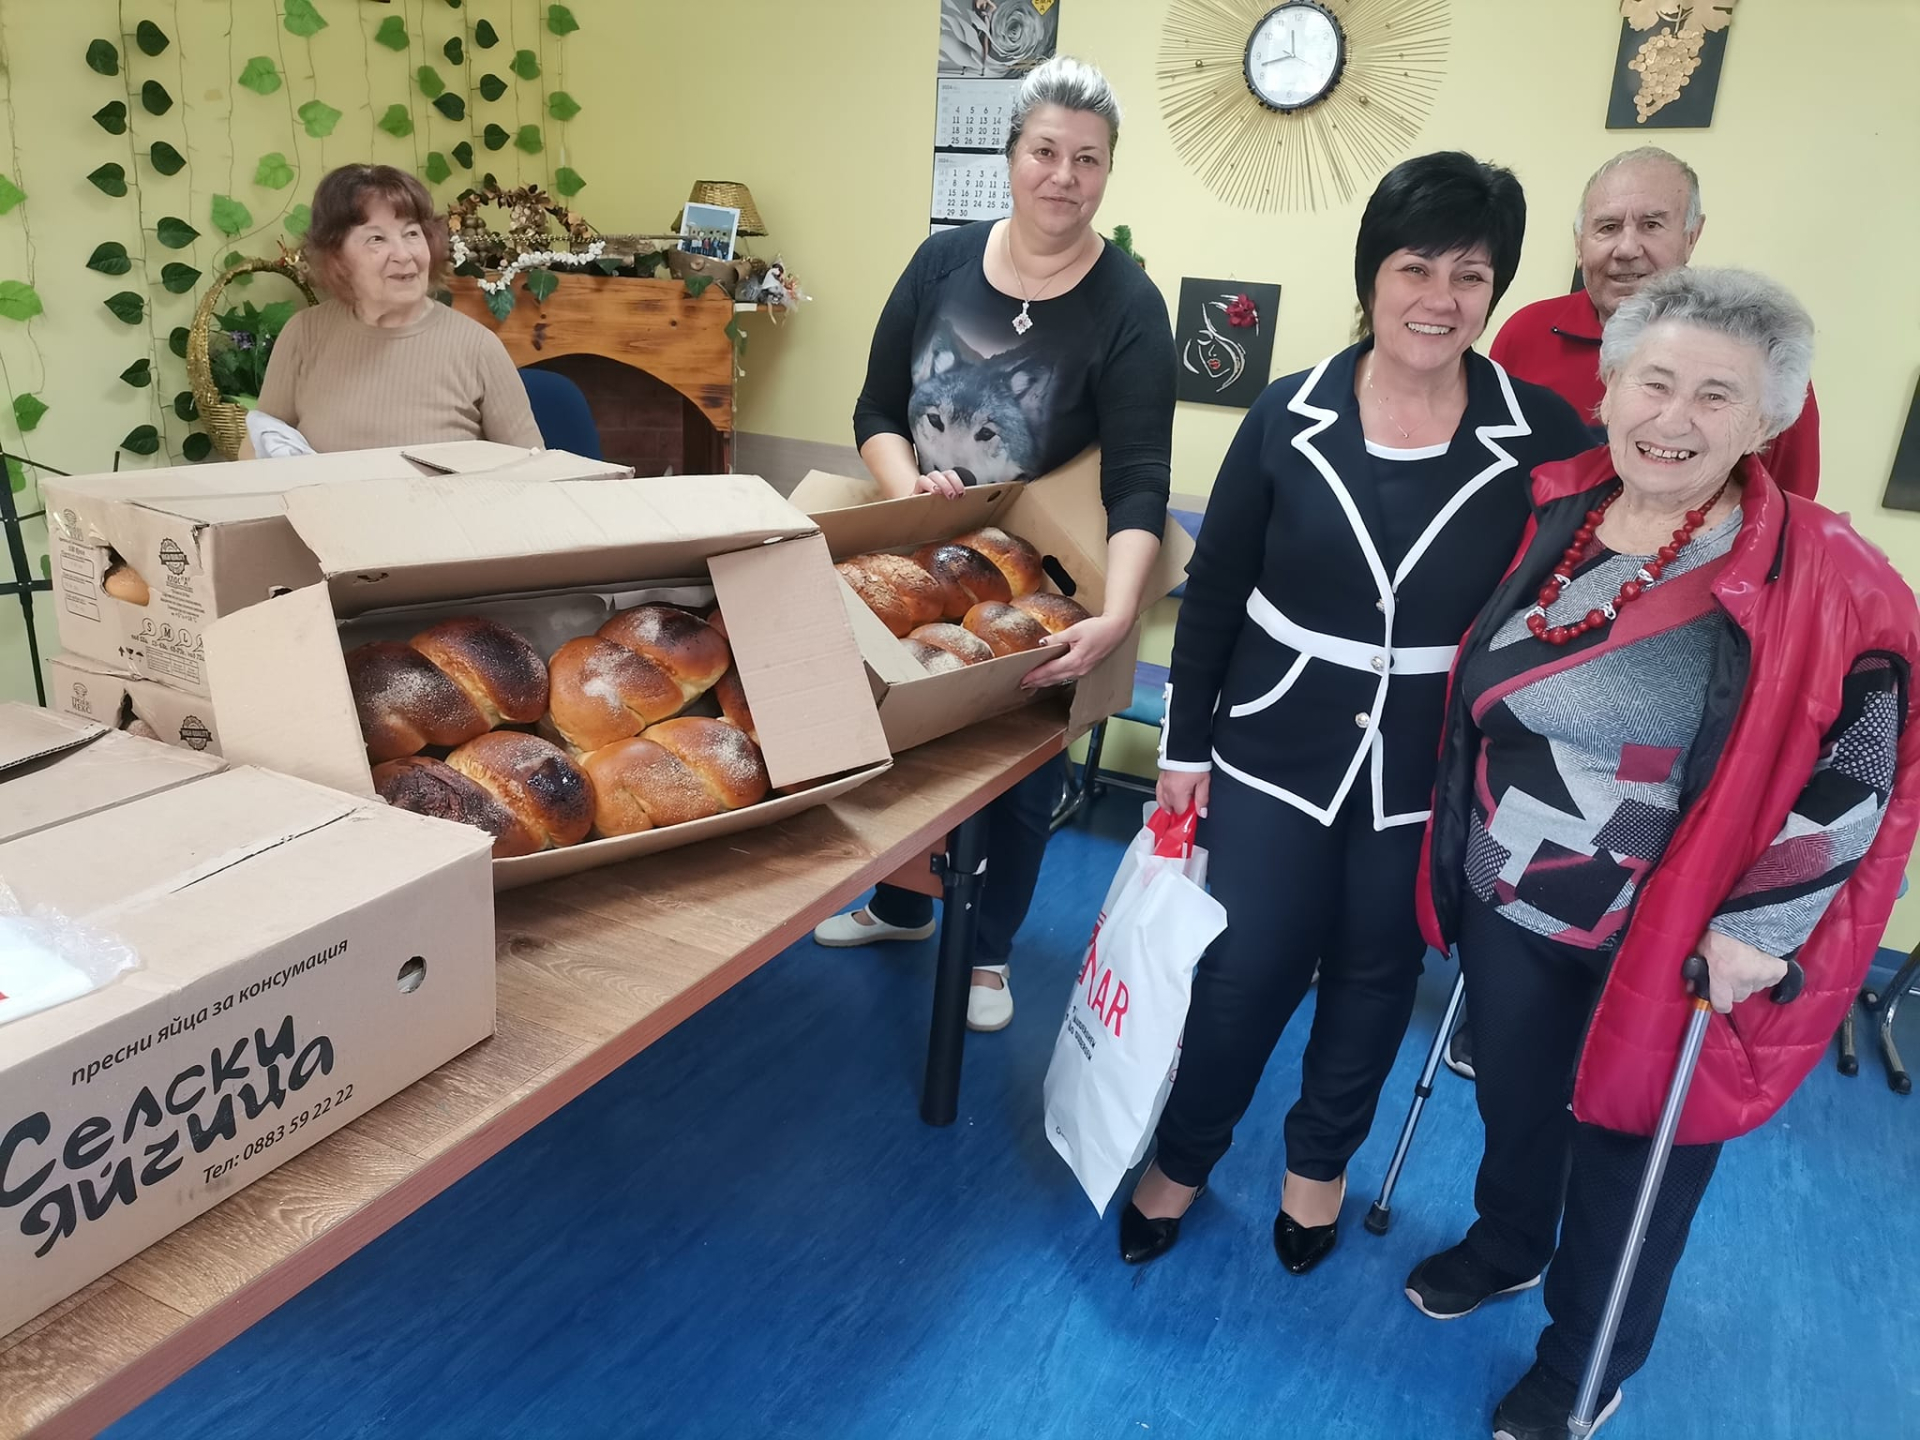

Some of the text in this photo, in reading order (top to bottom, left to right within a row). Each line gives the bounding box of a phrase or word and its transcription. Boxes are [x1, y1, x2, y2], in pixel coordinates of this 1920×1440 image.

[953, 116, 960, 124] 11
[966, 116, 974, 124] 12
[952, 126, 960, 134] 18
[978, 127, 987, 135] 20
[975, 180, 984, 188] 10
[961, 189, 969, 197] 16
[975, 190, 982, 198] 17
[960, 199, 968, 207] 23
[1001, 201, 1009, 209] 26
[959, 209, 968, 217] 30
[164, 627, 171, 638] M
[71, 938, 348, 1086] пресни яйца за консумация
[0, 1014, 296, 1208] Селски
[204, 1084, 354, 1186] Тел: 0883 59 22 22
